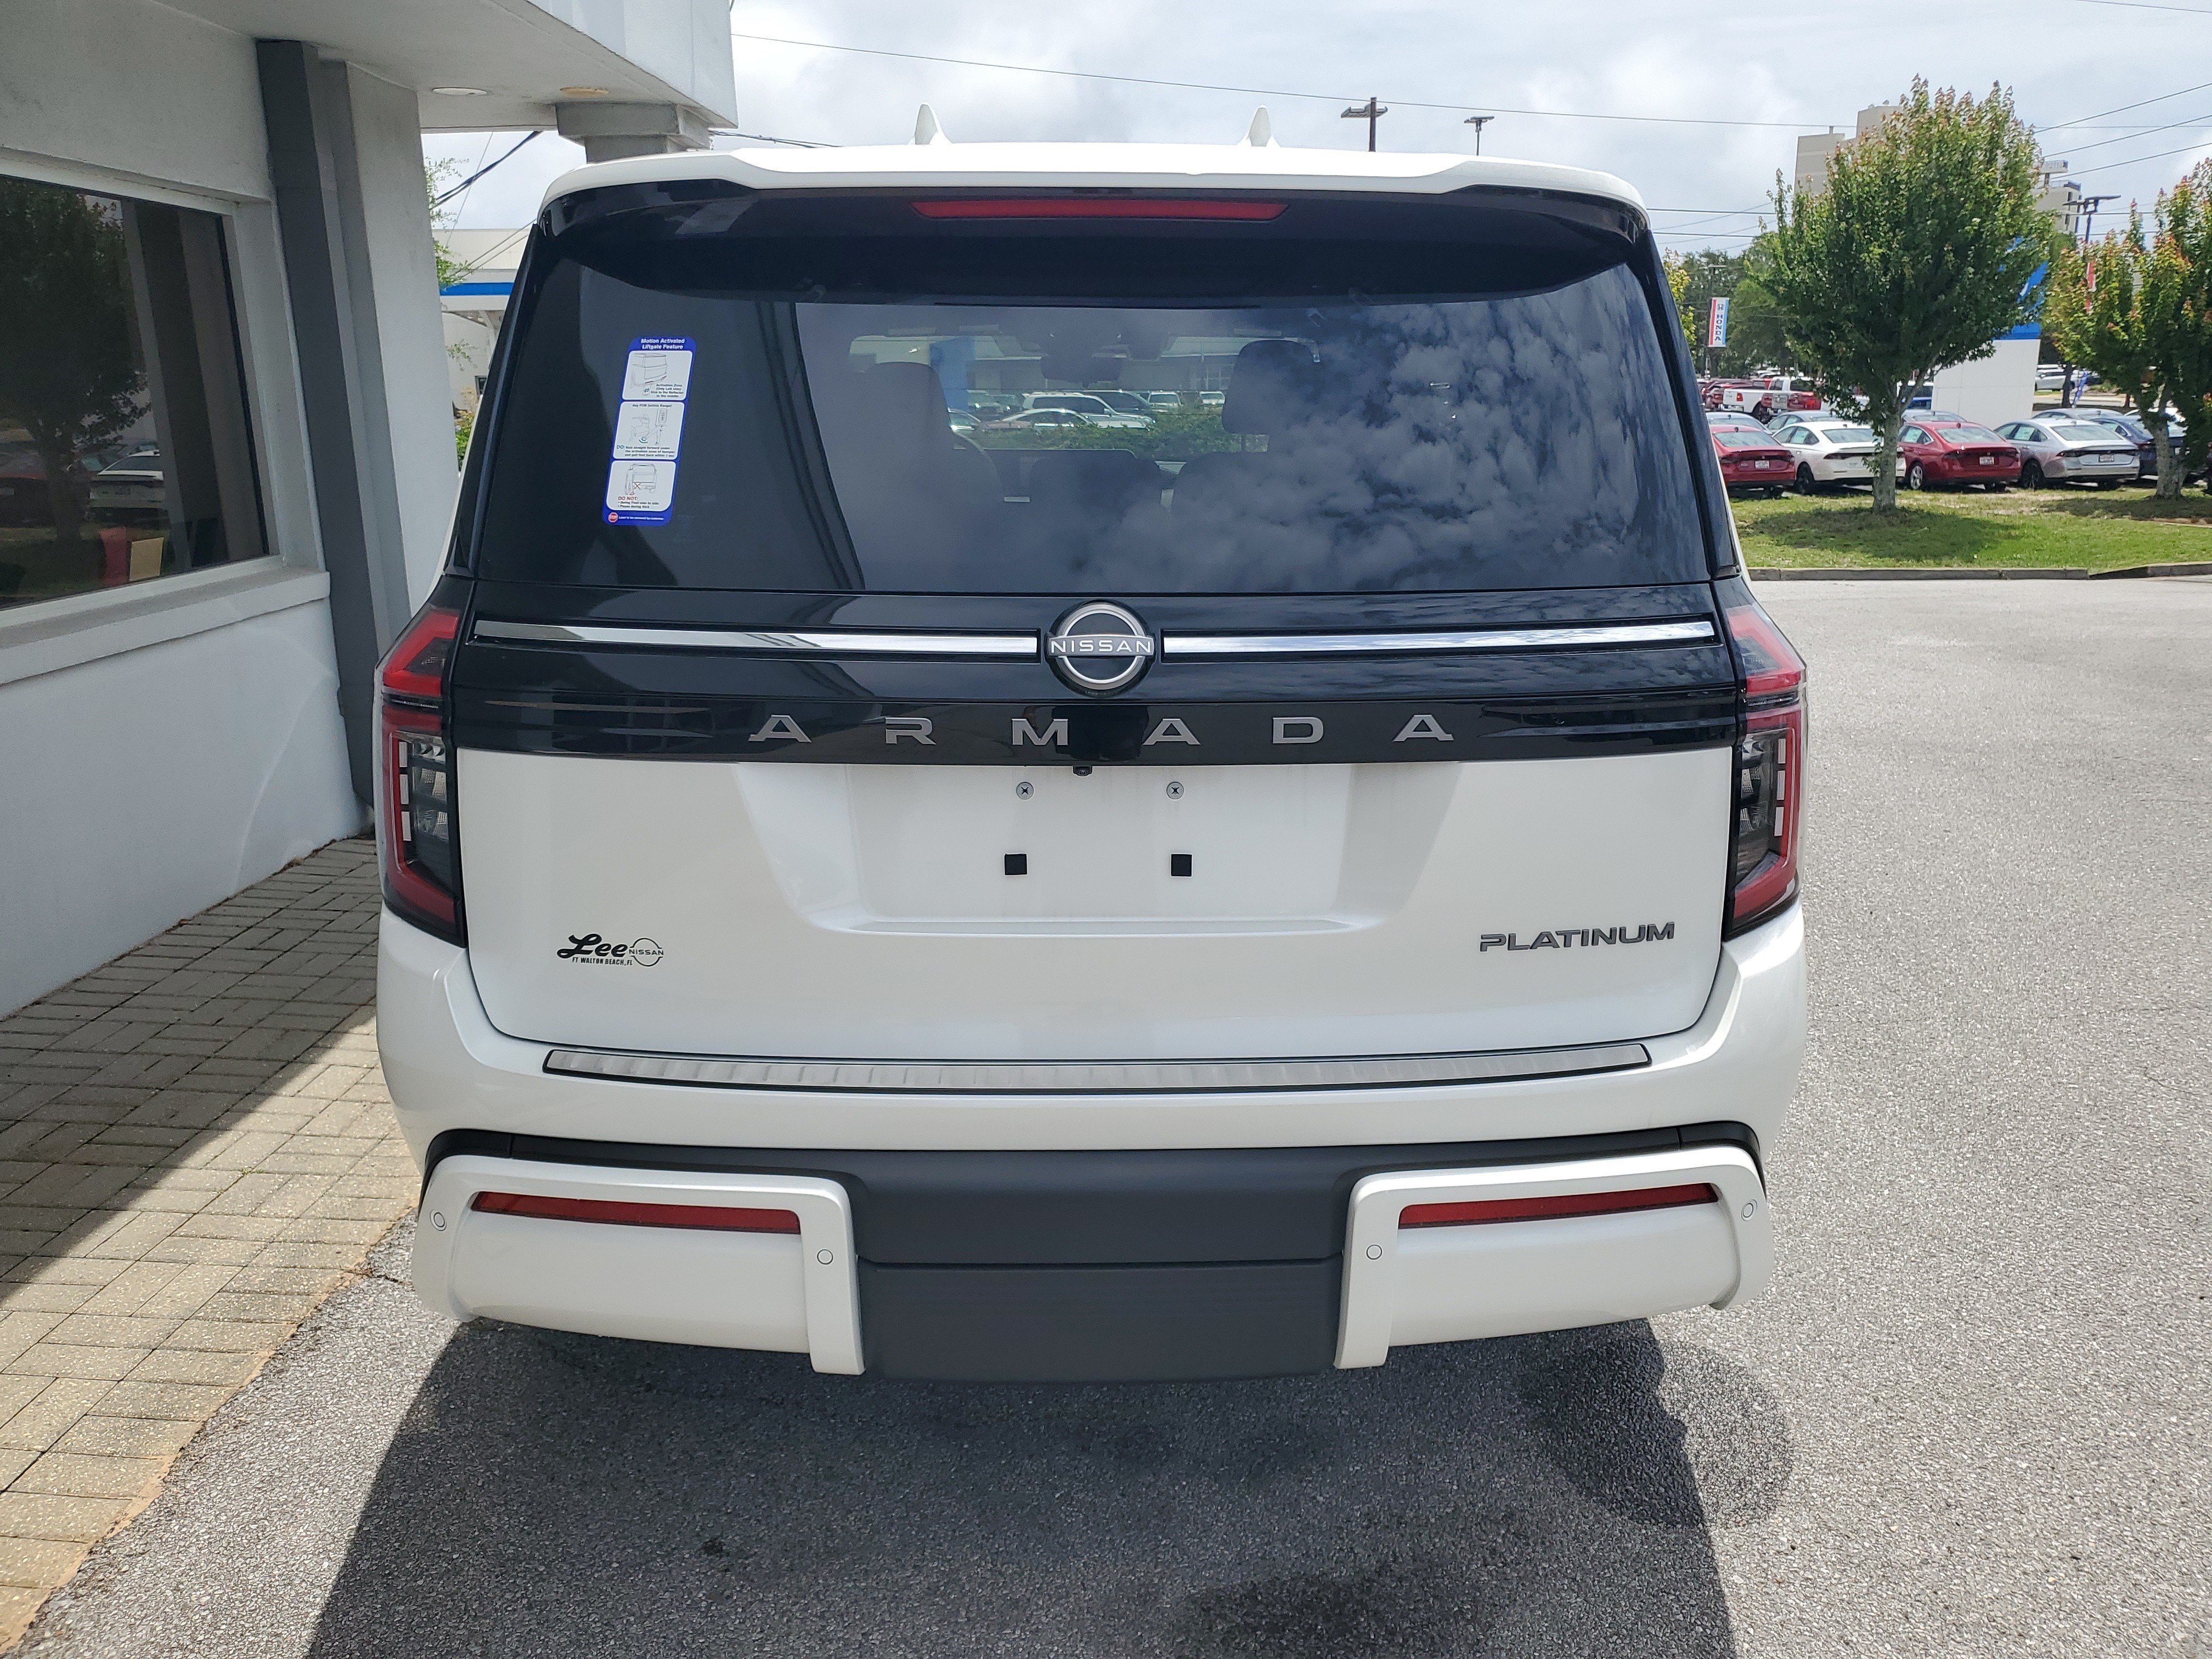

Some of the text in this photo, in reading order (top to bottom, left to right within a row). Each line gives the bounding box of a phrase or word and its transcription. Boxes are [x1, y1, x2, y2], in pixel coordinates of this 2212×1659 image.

[1714, 314, 1723, 341] HONDA
[1051, 640, 1151, 653] NISSAN
[748, 714, 1454, 745] ARMADA
[556, 933, 628, 959] Lee
[1480, 921, 1675, 952] PLATINUM
